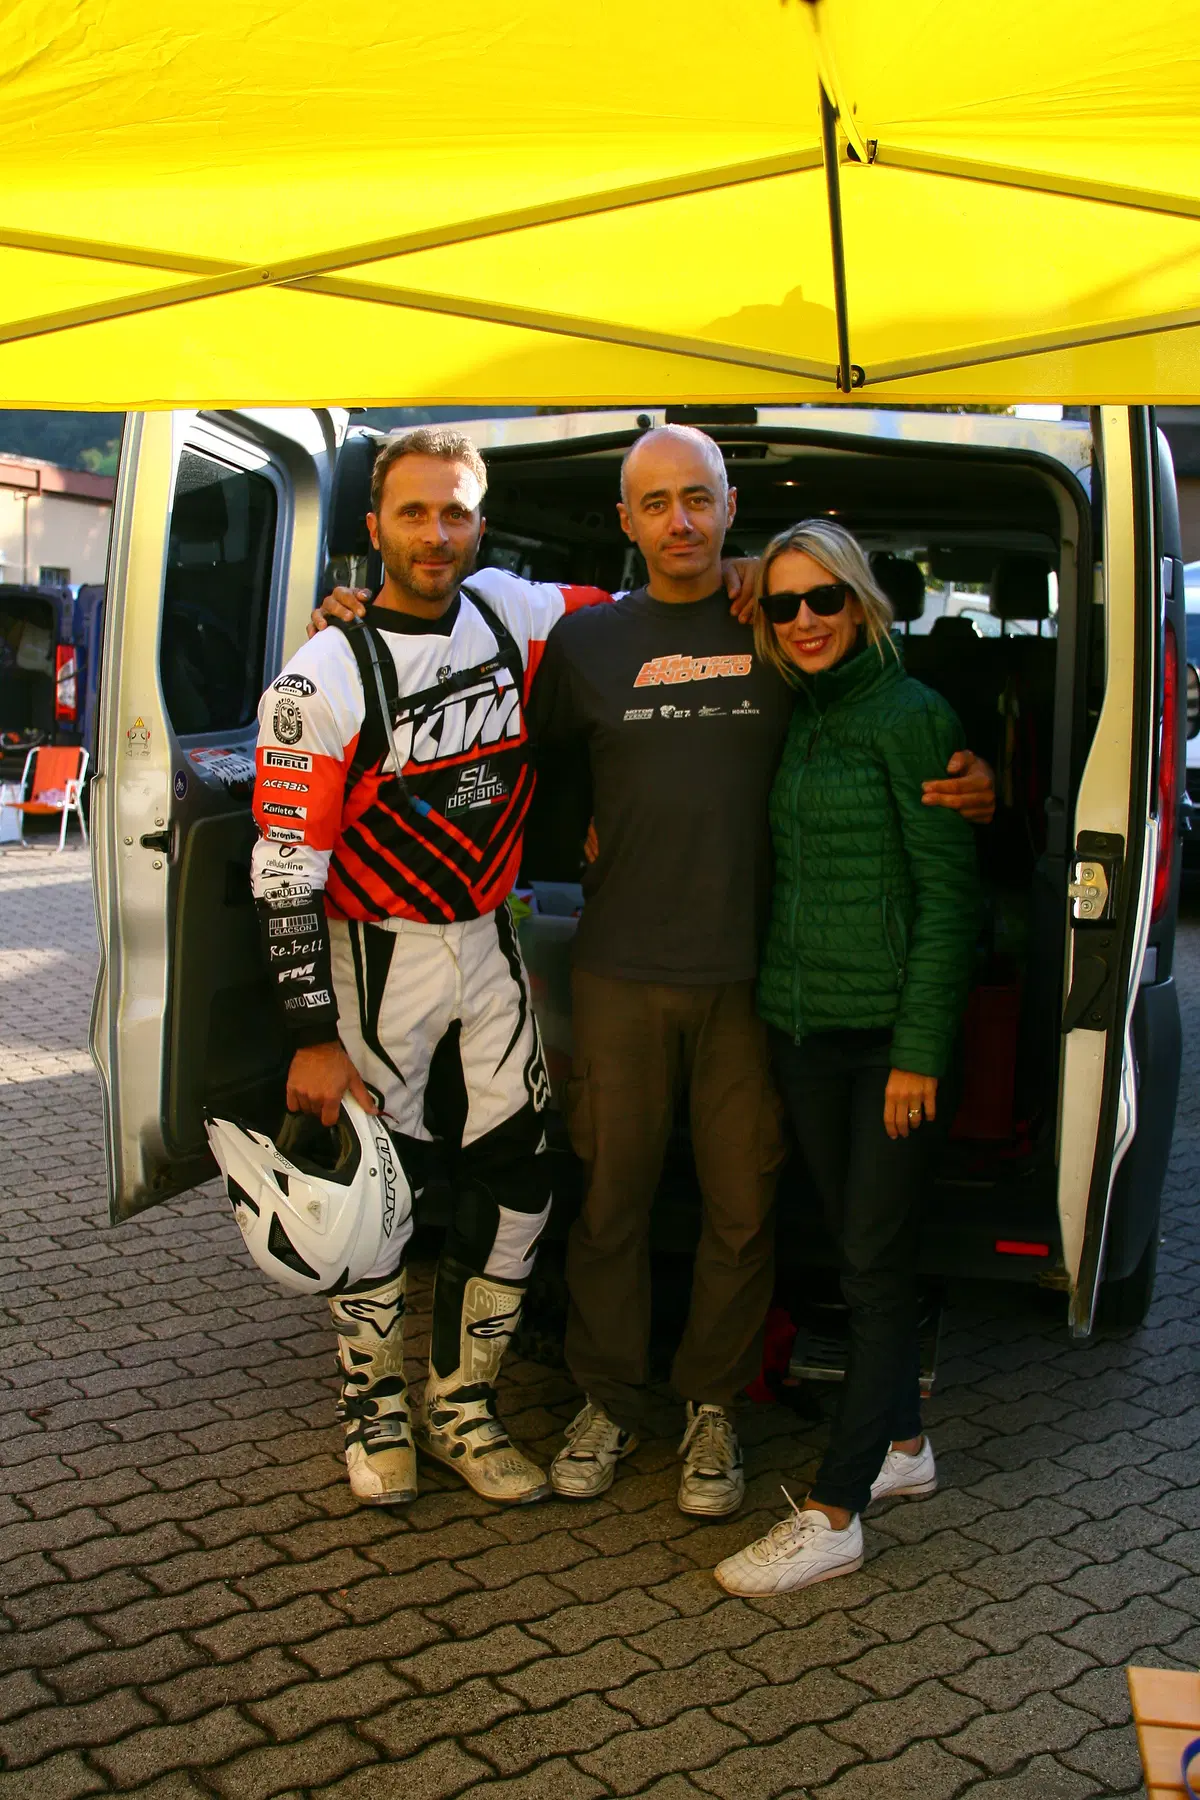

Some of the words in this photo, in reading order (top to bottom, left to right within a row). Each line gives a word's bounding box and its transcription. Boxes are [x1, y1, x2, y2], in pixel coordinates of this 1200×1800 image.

[633, 663, 752, 688] ENDURO
[381, 680, 520, 773] KTM
[266, 751, 309, 770] PIRELLI
[262, 779, 309, 793] ACERBIS
[457, 763, 498, 793] SL
